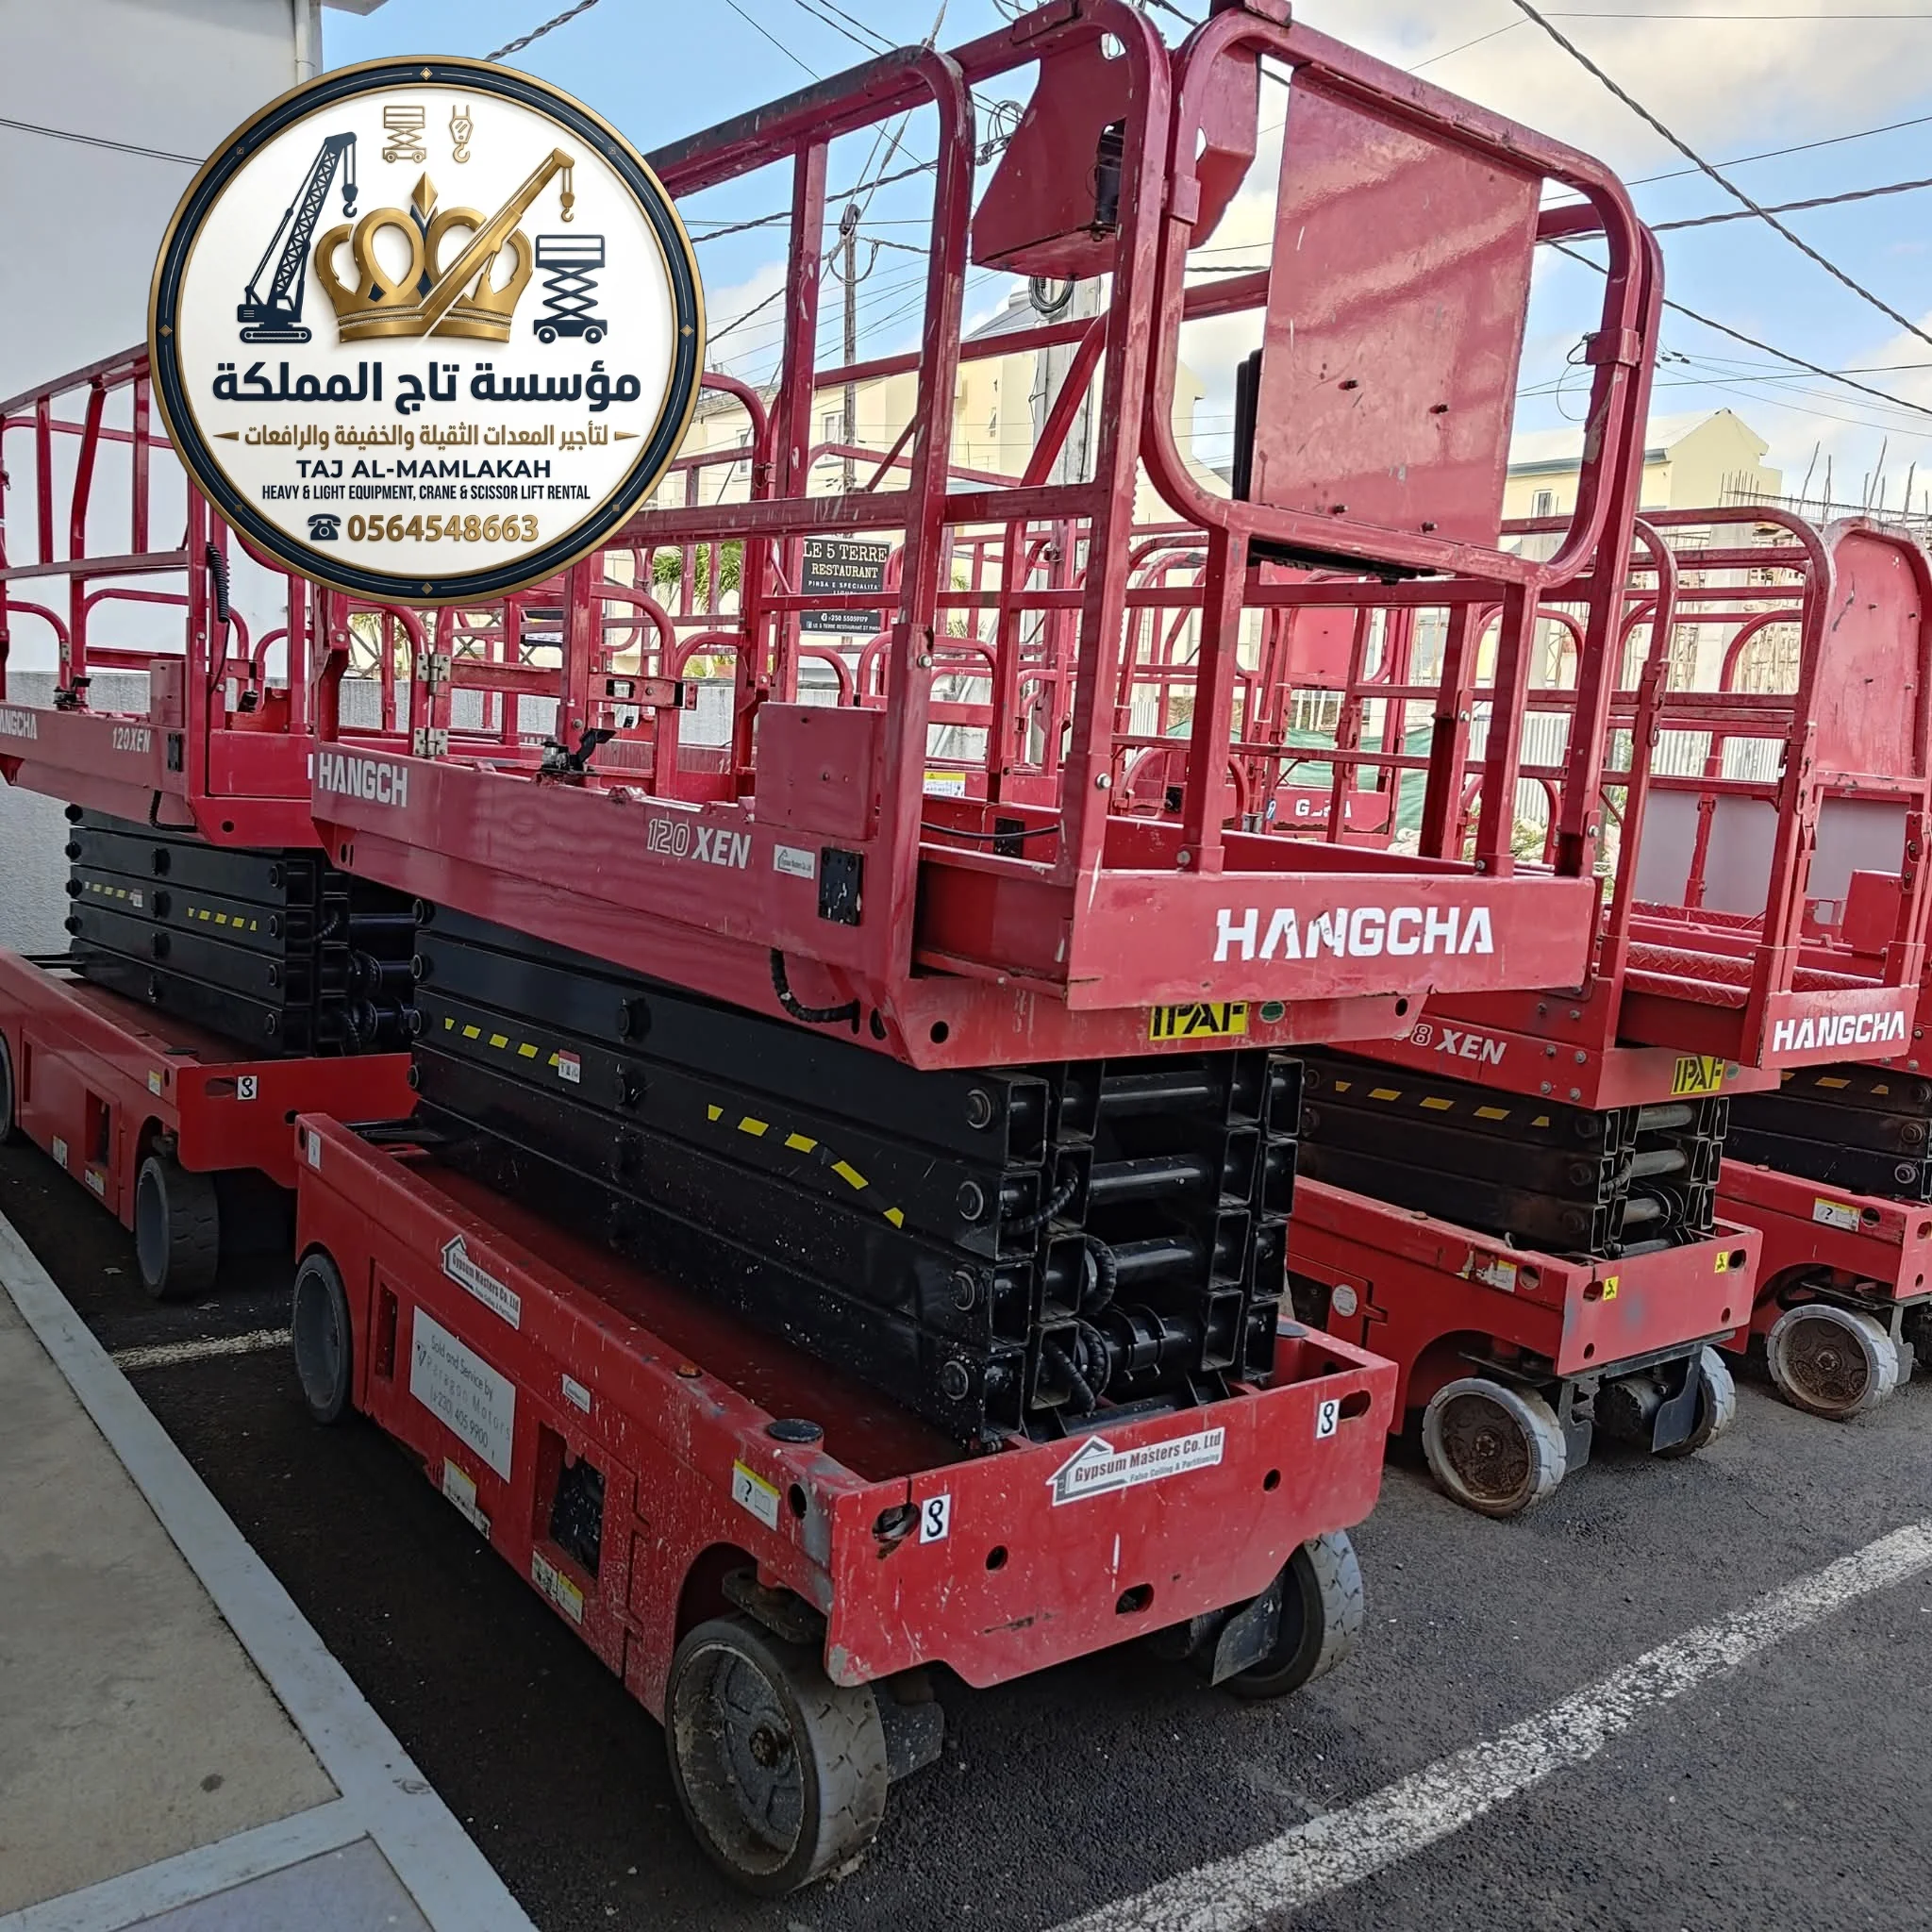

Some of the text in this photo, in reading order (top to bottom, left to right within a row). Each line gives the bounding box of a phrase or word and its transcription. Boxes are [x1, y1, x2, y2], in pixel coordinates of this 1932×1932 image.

[803, 541, 888, 563] LE 5 TERRE
[811, 562, 879, 578] RESTAURANT
[319, 752, 408, 808] HANGCH
[647, 818, 690, 857] 120
[691, 825, 752, 870] XEN
[1213, 907, 1494, 962] HANGCHA
[1410, 1024, 1507, 1065] 8 XEN
[1773, 1010, 1905, 1053] HANGCHA
[1674, 1056, 1724, 1093] IPAF
[431, 1335, 494, 1403] Sold and Service by
[454, 1407, 469, 1431] 405
[469, 1418, 489, 1449] 9900
[1074, 1431, 1223, 1486] Gypsum Masters Co. Ltd
